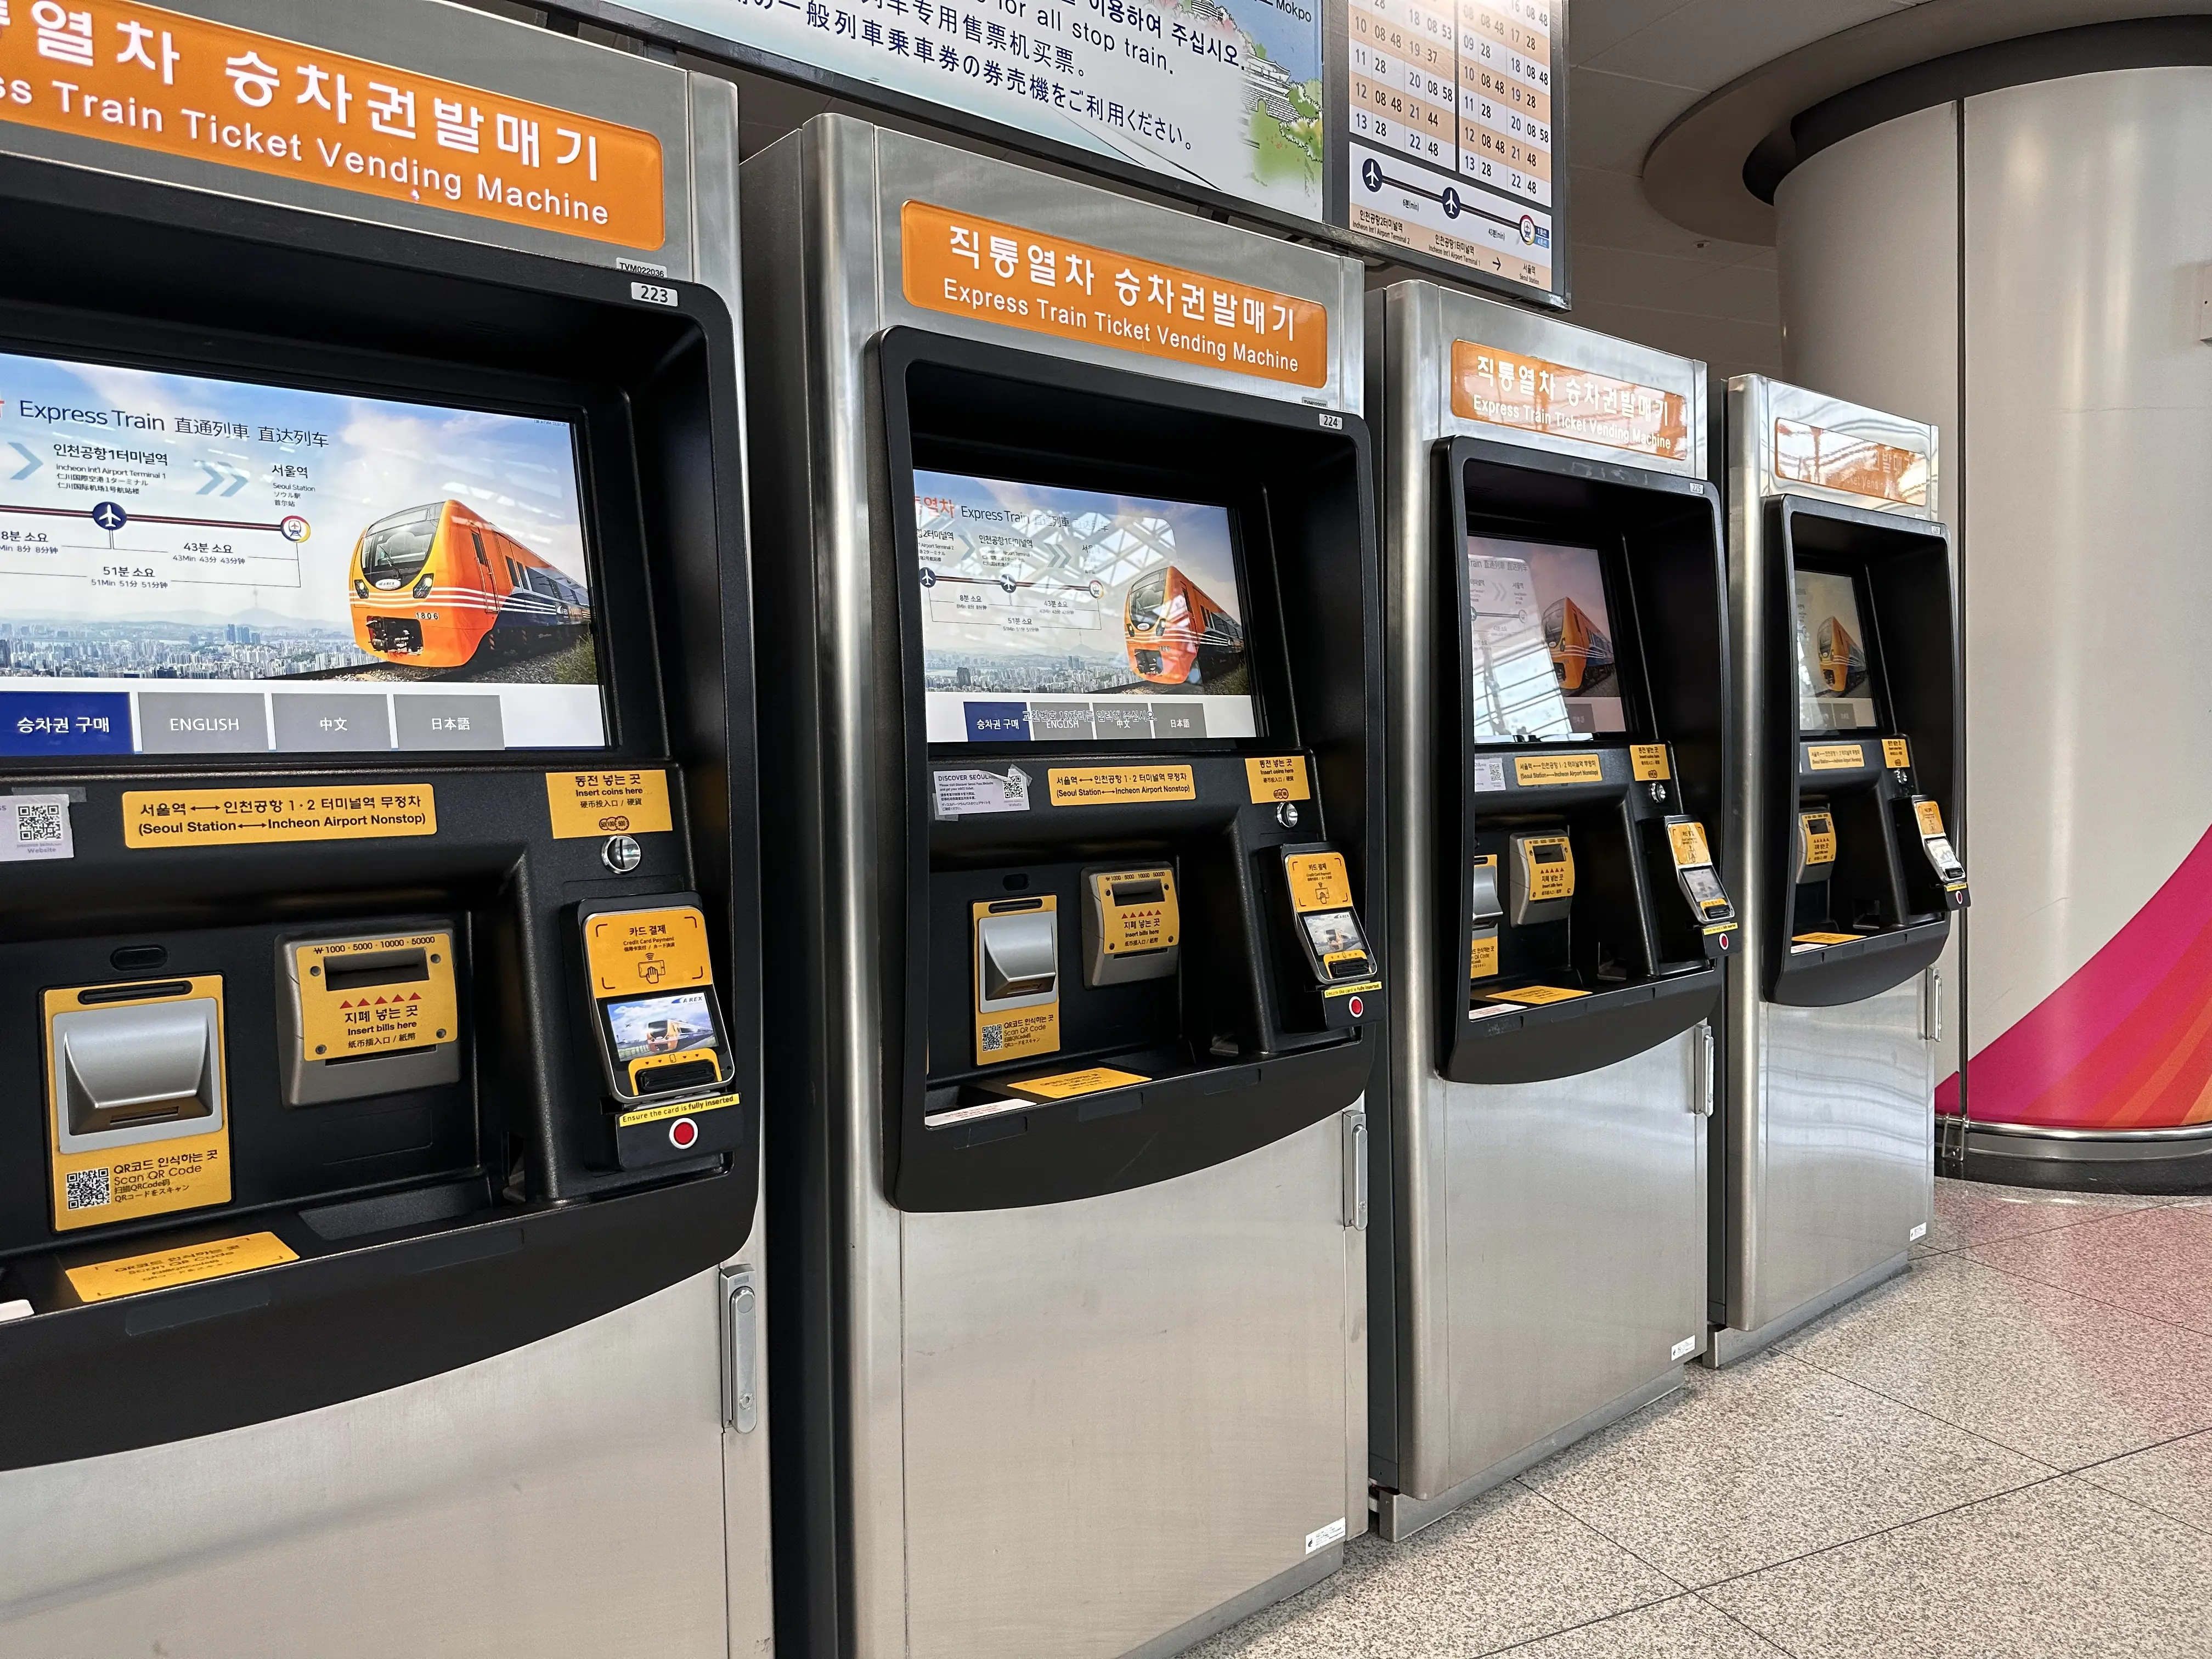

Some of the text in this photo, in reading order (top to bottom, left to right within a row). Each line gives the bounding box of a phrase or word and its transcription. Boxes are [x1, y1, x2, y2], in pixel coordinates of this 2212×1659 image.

[1276, 0, 1312, 22] Mokpo
[877, 0, 1085, 78] 车专用售票机买票。
[1037, 9, 1061, 31] all
[1072, 22, 1115, 52] stop
[1125, 40, 1174, 75] train.
[1356, 16, 1401, 48] 10 08 48
[1527, 36, 1536, 50] 28
[1171, 22, 1245, 70] 주십시오.
[1409, 41, 1437, 64] 19 37
[1481, 43, 1491, 59] 28
[1356, 49, 1386, 74] 11 28
[1511, 58, 1548, 86] 18 08 48
[738, 0, 1193, 151] 一般列車乗車券の券売機をご利用ください。
[1465, 66, 1504, 94] 10 08 48
[0, 0, 599, 182] 열차 승차권발매기
[1356, 82, 1402, 112] 12 08 48
[1409, 72, 1453, 102] 20 08 58
[1511, 87, 1536, 109] 19 28
[1409, 104, 1438, 127] 21 44
[1465, 96, 1491, 119] 11 28
[1356, 113, 1386, 137] 13 28
[1511, 116, 1549, 143] 20 08 58
[1410, 133, 1438, 157] 22 48
[1465, 127, 1505, 154] 12 08 48
[52, 80, 610, 225] Train Ticket Vending Machine
[1511, 146, 1536, 167] 21 48
[1465, 155, 1492, 177] 13 28
[1511, 173, 1536, 195] 22 48
[1360, 210, 1403, 233] 인천공항2터미널역
[619, 262, 664, 278] TVM022036
[641, 285, 668, 303] 223
[949, 225, 1295, 342] 직통열차 승차권발매기
[944, 277, 1299, 374] Express Train Ticket Vending Machine
[1477, 355, 1669, 426] 직통열차 승차권발매기
[20, 399, 329, 448] Express Train 直通列車 直达列车
[1323, 415, 1338, 427] 224
[1473, 393, 1671, 450] Express Train Ticket Vending Machine
[53, 443, 168, 466] 인천공항1터미널역
[56, 464, 160, 478] Incheon Airport Terminal
[272, 464, 309, 479] 서울역
[292, 484, 316, 492] Station
[1691, 483, 1702, 493] 225
[961, 505, 1030, 524] Express Train
[1, 531, 49, 543] 8분 소요
[183, 542, 234, 554] 43분 소요
[979, 534, 1033, 548] 인천공항1터미널역
[103, 566, 156, 577] 51분 소요
[16, 716, 110, 733] 승차권 구매
[170, 718, 240, 731] ENGLISH
[319, 716, 348, 732] 中文
[431, 716, 471, 732] 日本語
[977, 719, 1019, 730] 승차권 구매
[1170, 719, 1190, 729] 日本語
[575, 774, 641, 787] 동전 넣는 곳
[1057, 772, 1187, 786] 서울역 인천공항 터미널역 무정차
[1057, 789, 1077, 798] (Seoul
[1142, 786, 1163, 794] Airport
[1164, 784, 1190, 792] Nonstop)
[140, 795, 421, 817] 서울역 인천공항 터미널역 무정차
[138, 812, 426, 836] (Seoul Station Incheon Airport Nonstop)
[629, 924, 667, 936] 카드 결제
[353, 936, 436, 951] 5000 10000 50000
[345, 1005, 419, 1024] 지폐 넣는 곳
[347, 1020, 417, 1036] Insert bills here
[1030, 1024, 1046, 1032] Code
[622, 1111, 648, 1123] Ensure
[650, 1109, 662, 1118] the
[664, 1105, 680, 1115] card
[689, 1101, 704, 1110] fully
[706, 1096, 734, 1107] inserted
[114, 1149, 218, 1175] QR코드 인식하는 곳
[114, 1164, 202, 1186] Scan QR Code
